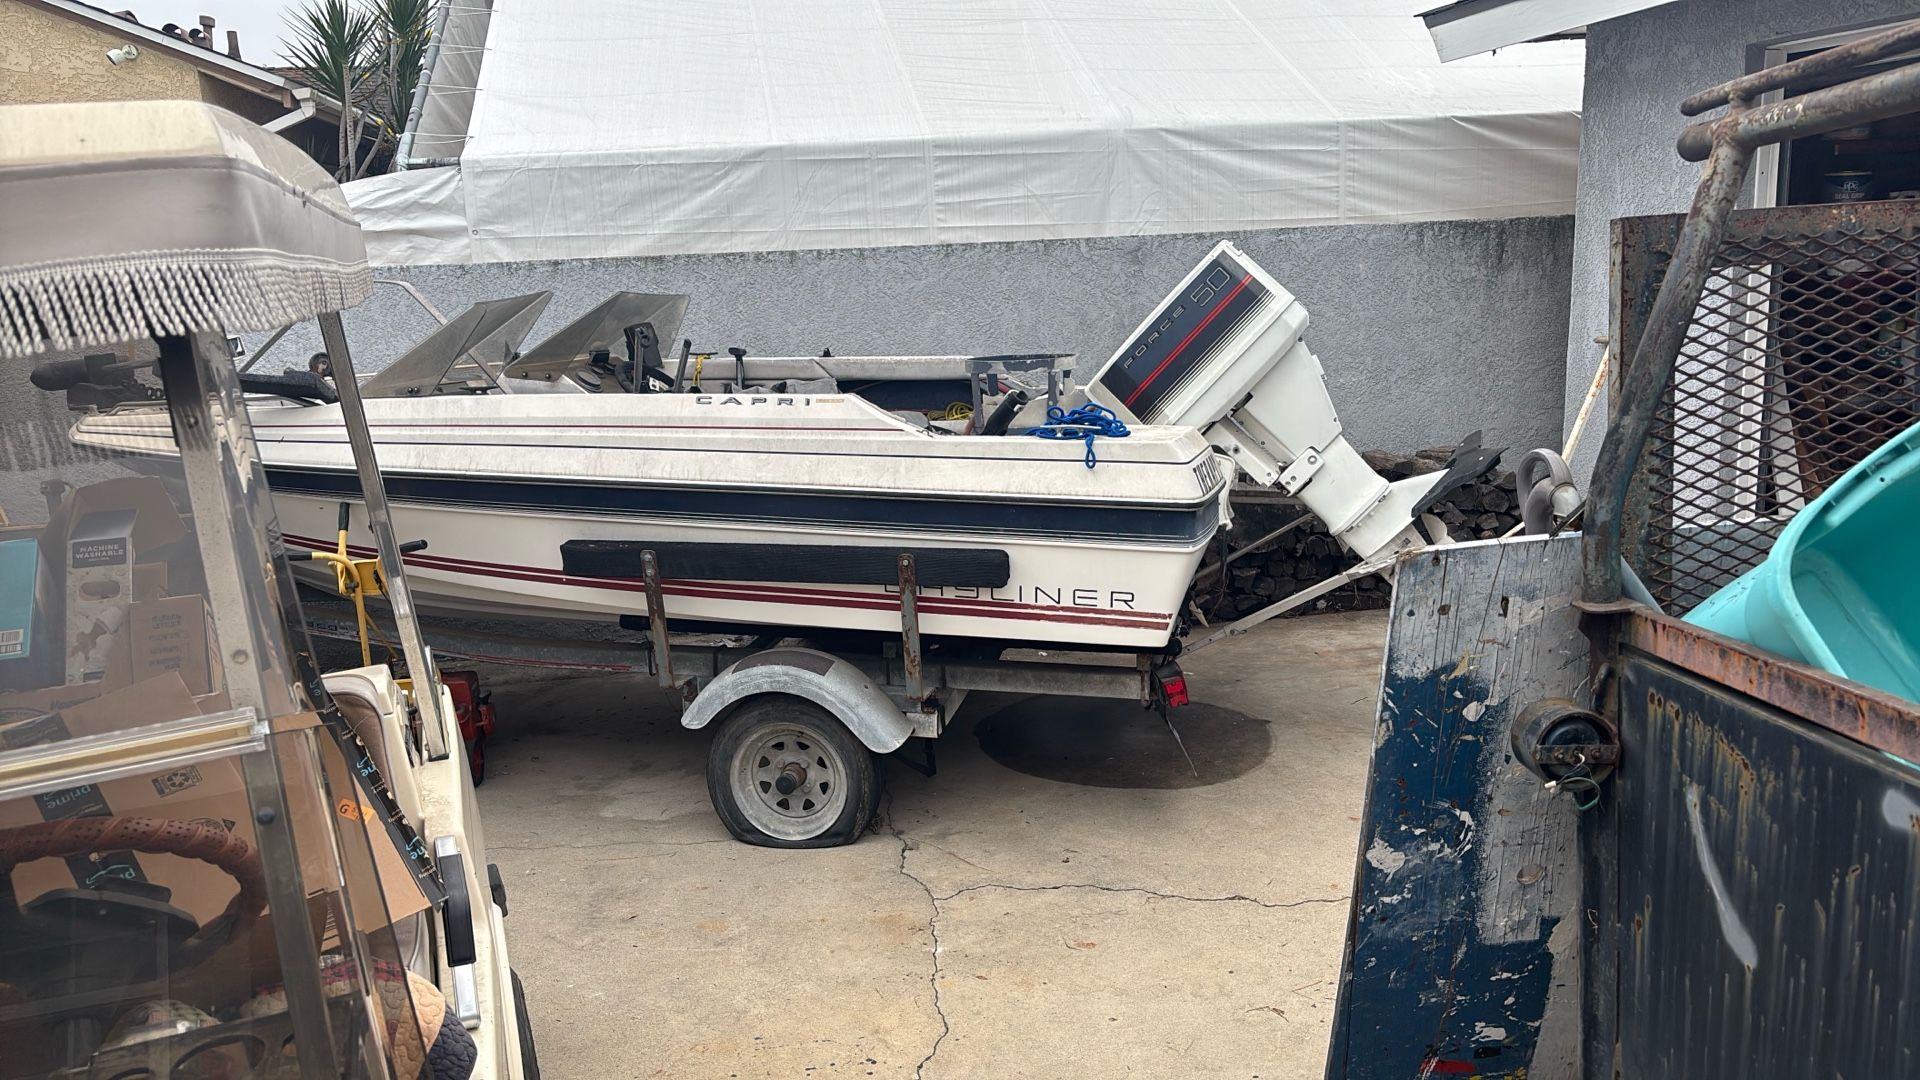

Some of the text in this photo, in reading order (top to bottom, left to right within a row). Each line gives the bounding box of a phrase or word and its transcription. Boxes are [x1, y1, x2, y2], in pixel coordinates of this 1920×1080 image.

[1123, 266, 1232, 369] FORCE 50
[695, 395, 811, 407] CAPRI
[79, 543, 120, 553] MACHINE
[75, 549, 124, 560] WASHABLE
[47, 784, 92, 809] prime
